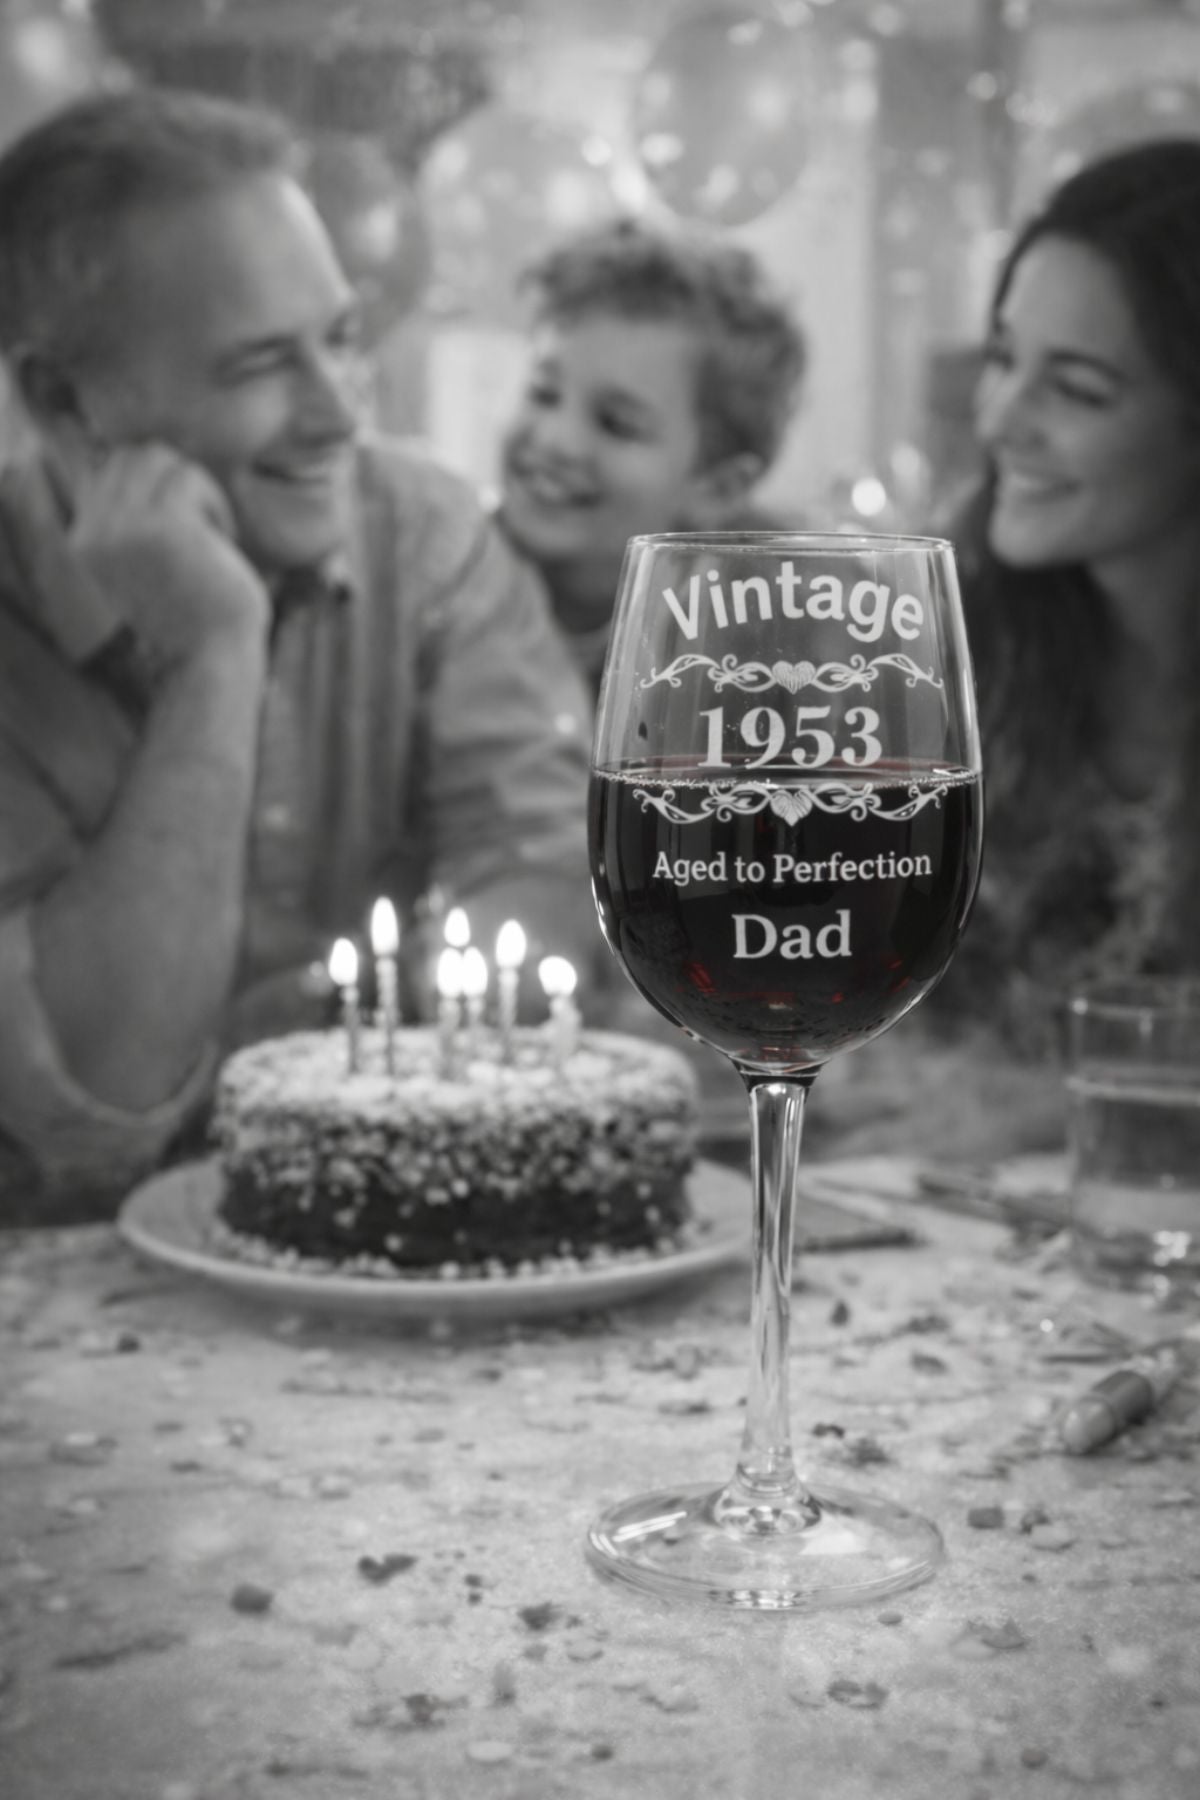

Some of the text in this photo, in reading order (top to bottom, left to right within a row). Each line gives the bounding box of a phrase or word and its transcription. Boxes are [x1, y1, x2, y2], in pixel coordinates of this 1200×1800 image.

[662, 561, 925, 643] Vintage
[697, 706, 883, 769] 1953
[652, 851, 933, 887] Aged to Perfection
[731, 909, 852, 959] Dad
